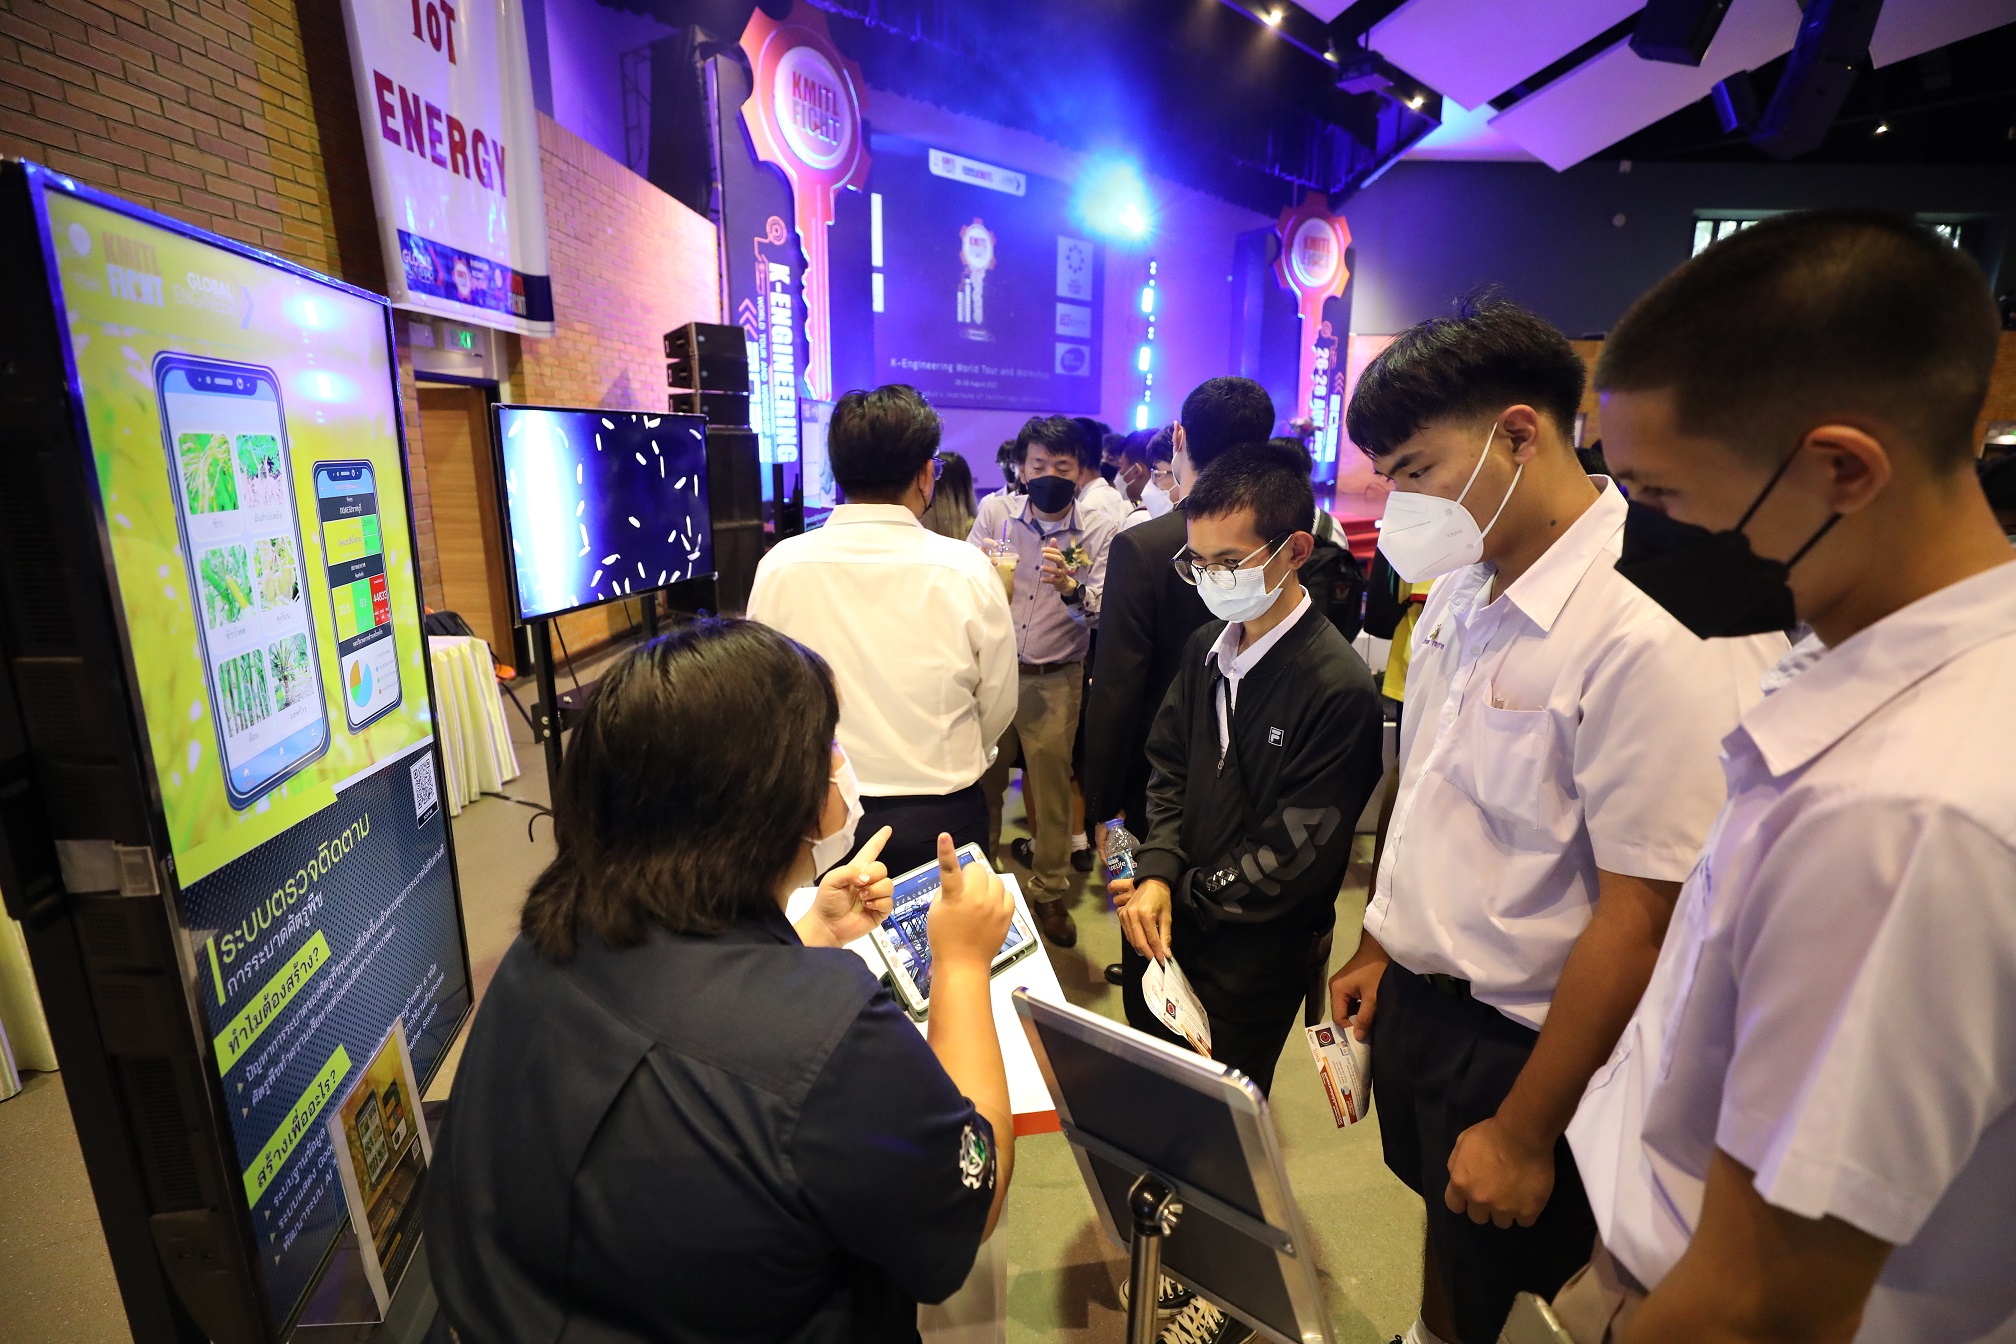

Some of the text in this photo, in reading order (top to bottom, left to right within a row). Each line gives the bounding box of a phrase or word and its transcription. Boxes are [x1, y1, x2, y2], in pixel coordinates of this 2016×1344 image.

[411, 0, 457, 67] IoT
[793, 71, 839, 117] KMITL
[373, 69, 507, 198] ENERGY
[187, 272, 234, 299] GLOBAL
[756, 295, 766, 331] WORLD
[450, 329, 476, 349] EXIT
[758, 332, 768, 359] TOUR
[769, 262, 798, 464] K-ENGINEERING
[890, 358, 953, 373] K-Engineering
[955, 363, 979, 374] World
[981, 364, 998, 375] Tour
[222, 812, 371, 964] ระบบตรวจติดตาม
[227, 891, 324, 997] การระบาดศัตรูพืช
[228, 946, 321, 1056] ทำไมต้องสร้าง?
[257, 1069, 338, 1188] สร้างเพื่ออะไร?
